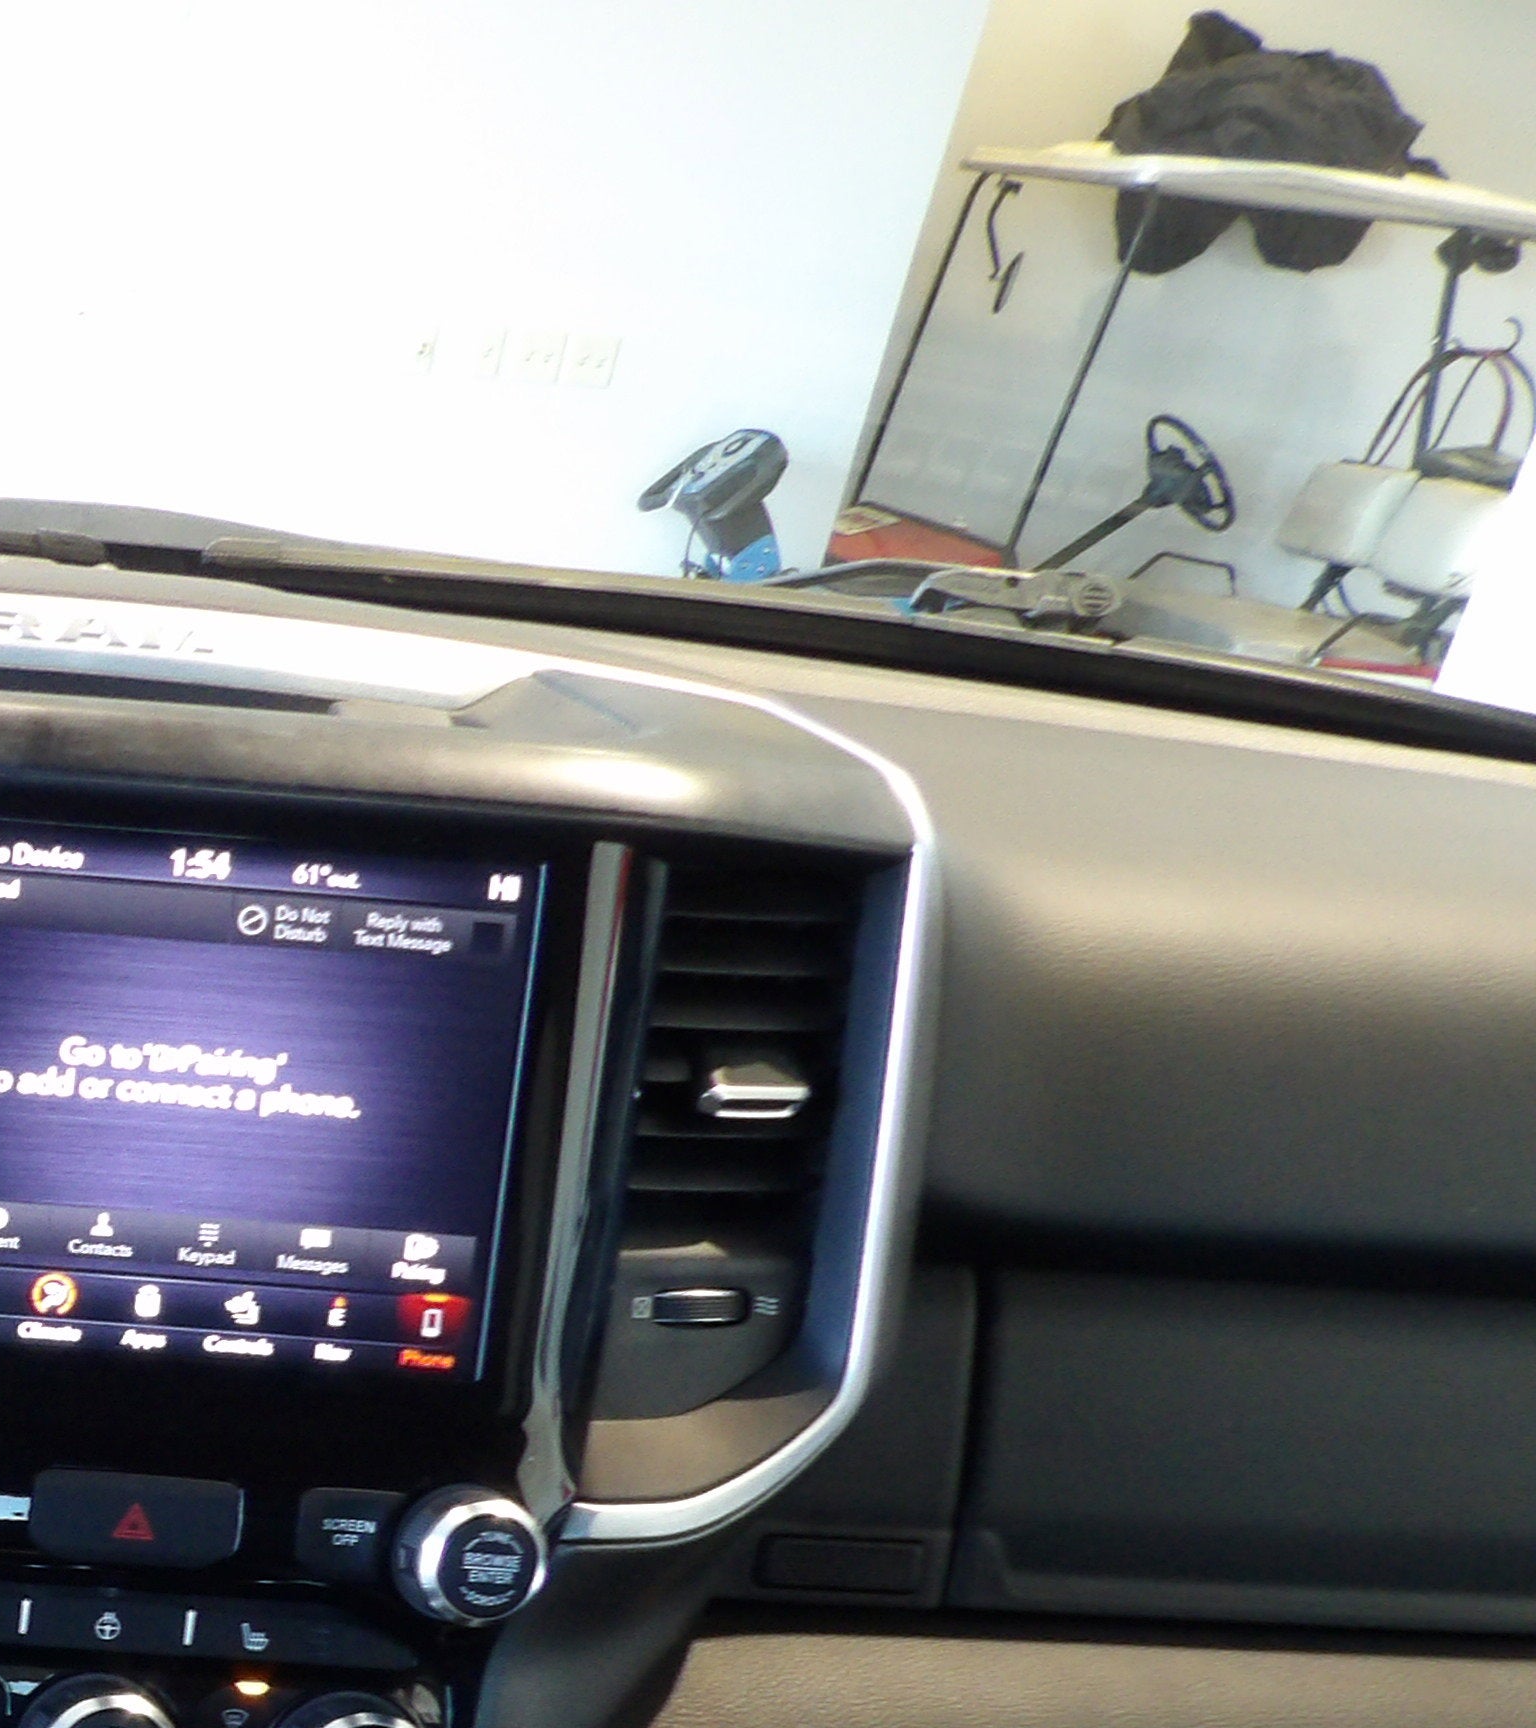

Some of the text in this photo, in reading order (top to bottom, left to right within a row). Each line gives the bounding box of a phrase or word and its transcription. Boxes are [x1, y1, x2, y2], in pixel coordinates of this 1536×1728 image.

[170, 848, 231, 880] 1:54
[275, 905, 331, 925] Do Not
[365, 912, 443, 934] Reply with
[273, 924, 327, 943] Disturb
[353, 928, 453, 955] Text Message
[59, 1035, 106, 1068] Go
[109, 1043, 143, 1070] to
[17, 1066, 76, 1098] add
[78, 1077, 114, 1099] or
[115, 1079, 233, 1110] connect
[234, 1088, 256, 1111] a
[259, 1084, 361, 1119] phone.
[67, 1238, 134, 1258] Contacts
[177, 1247, 237, 1267] Keypad
[276, 1253, 349, 1276] Messages
[322, 1518, 377, 1534] SCREEN
[331, 1534, 359, 1547] OFF
[463, 1551, 523, 1568] BROWSE
[467, 1569, 514, 1585] ENTER
